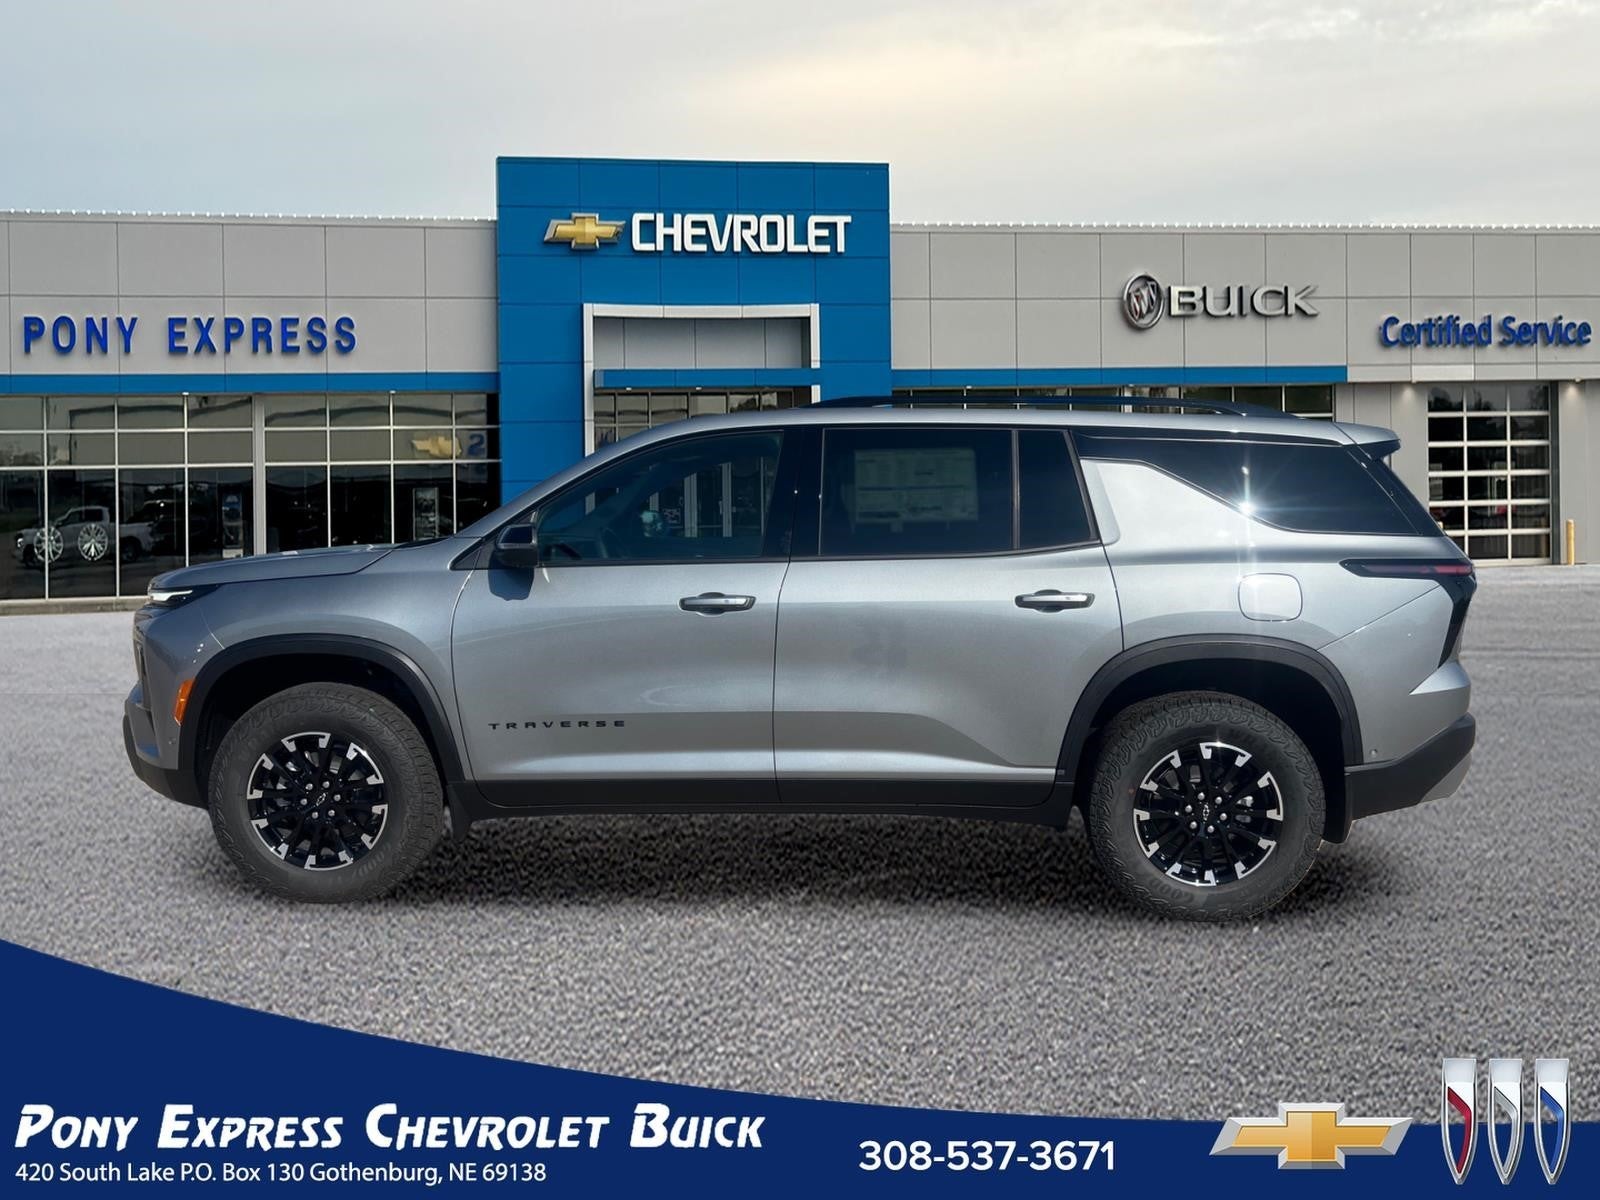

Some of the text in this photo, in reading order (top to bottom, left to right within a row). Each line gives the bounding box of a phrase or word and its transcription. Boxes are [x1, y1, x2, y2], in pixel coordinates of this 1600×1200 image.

[631, 212, 852, 253] CHEVROLET
[1168, 285, 1320, 318] BUICK
[23, 315, 357, 354] PONY EXPRESS
[1380, 315, 1592, 348] Certified Service
[488, 720, 626, 730] TRAVERSE
